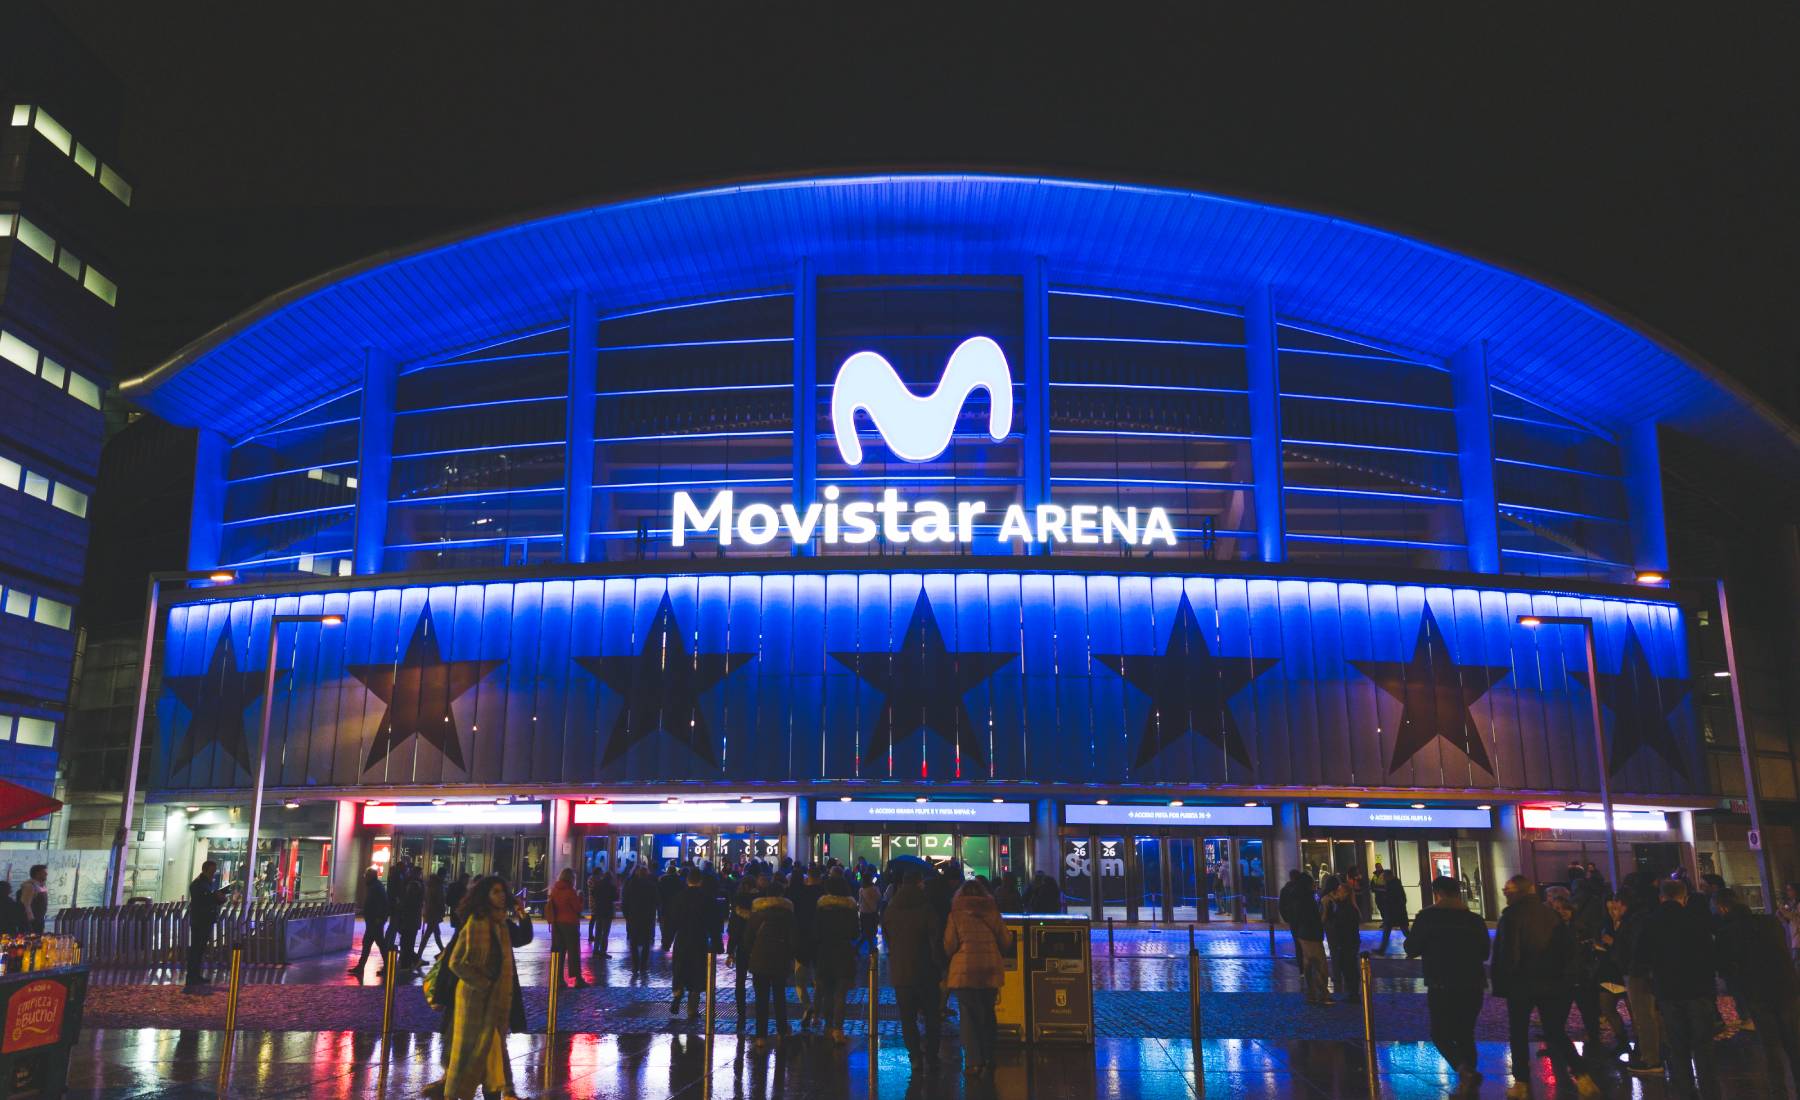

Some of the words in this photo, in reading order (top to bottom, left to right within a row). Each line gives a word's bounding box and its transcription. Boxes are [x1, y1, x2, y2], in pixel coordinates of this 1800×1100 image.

[671, 485, 986, 547] Movistar
[998, 504, 1177, 545] ARENA
[766, 845, 779, 854] 01
[1073, 847, 1086, 857] 26
[1103, 847, 1116, 857] 26
